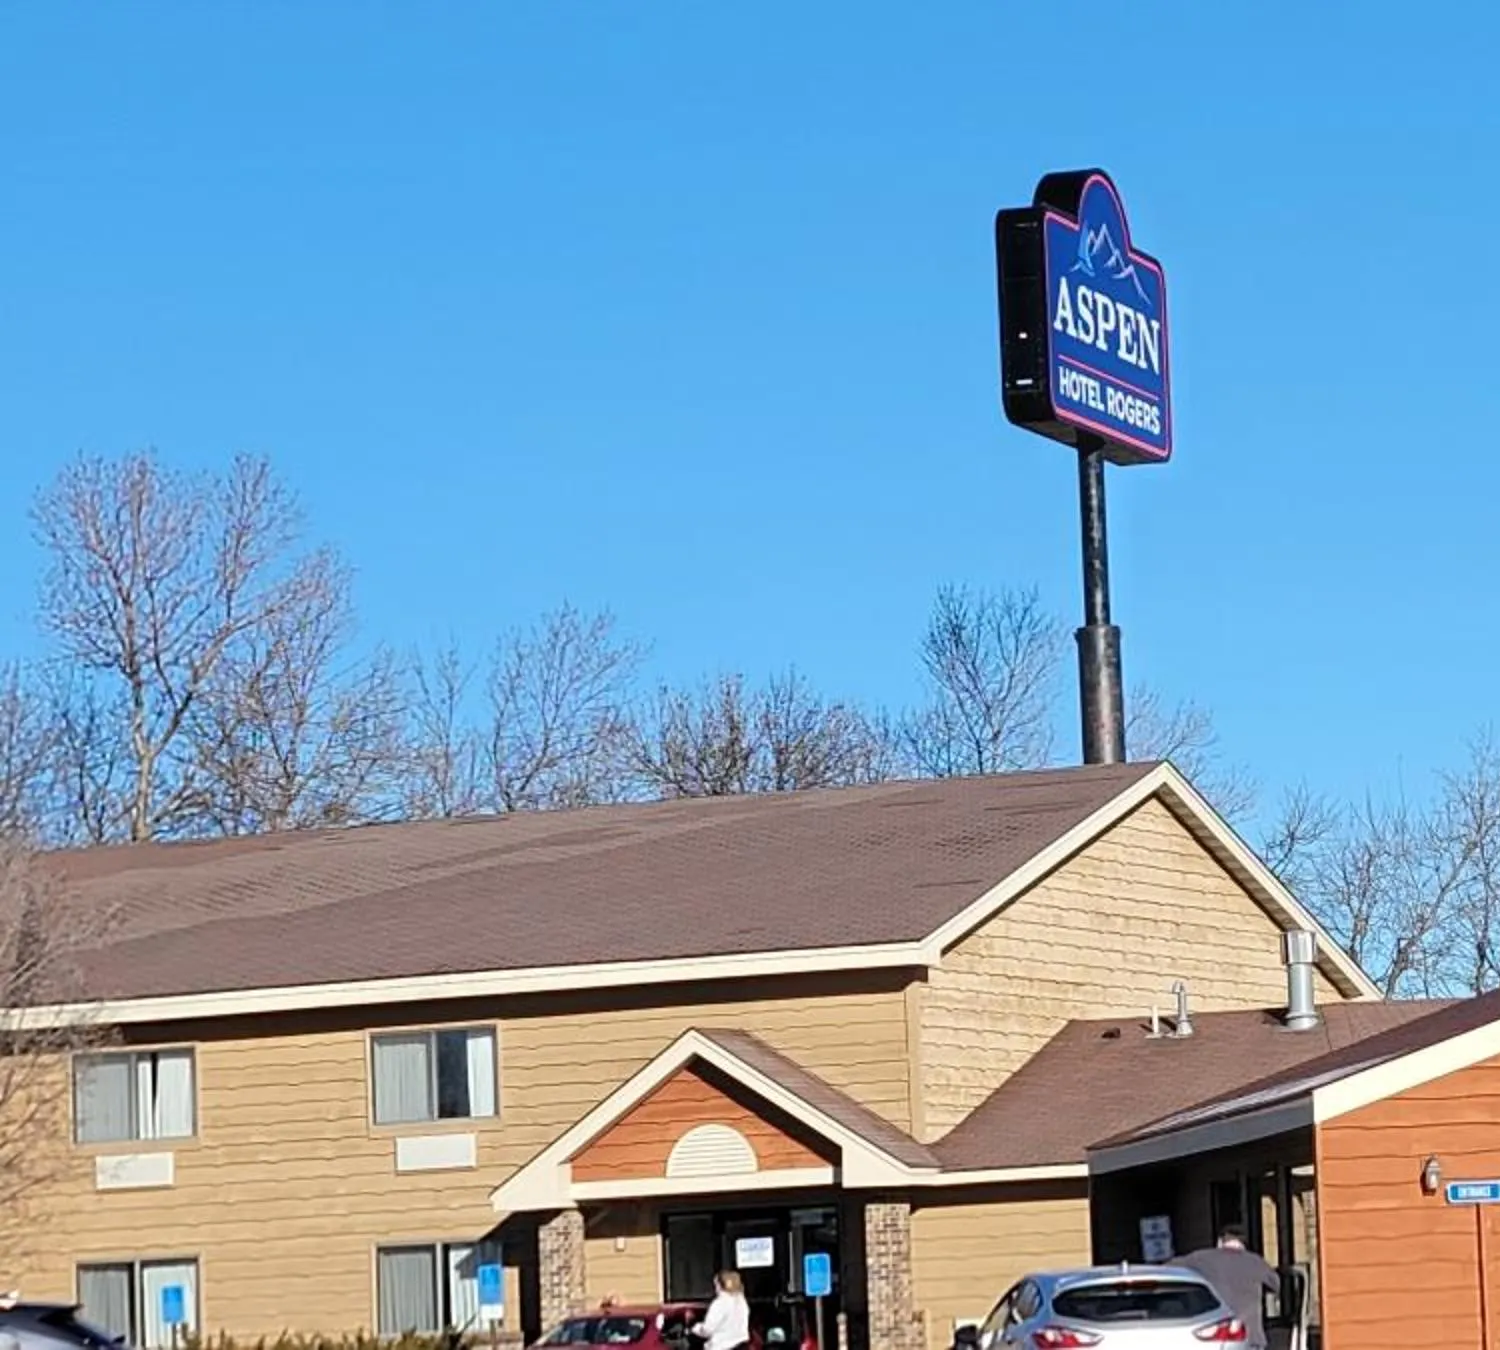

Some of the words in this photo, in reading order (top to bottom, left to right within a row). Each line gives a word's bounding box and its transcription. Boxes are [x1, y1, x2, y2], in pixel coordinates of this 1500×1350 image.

[1054, 276, 1159, 375] ASPEN
[1058, 366, 1105, 411] HOTEL
[1106, 386, 1160, 435] ROGERS
